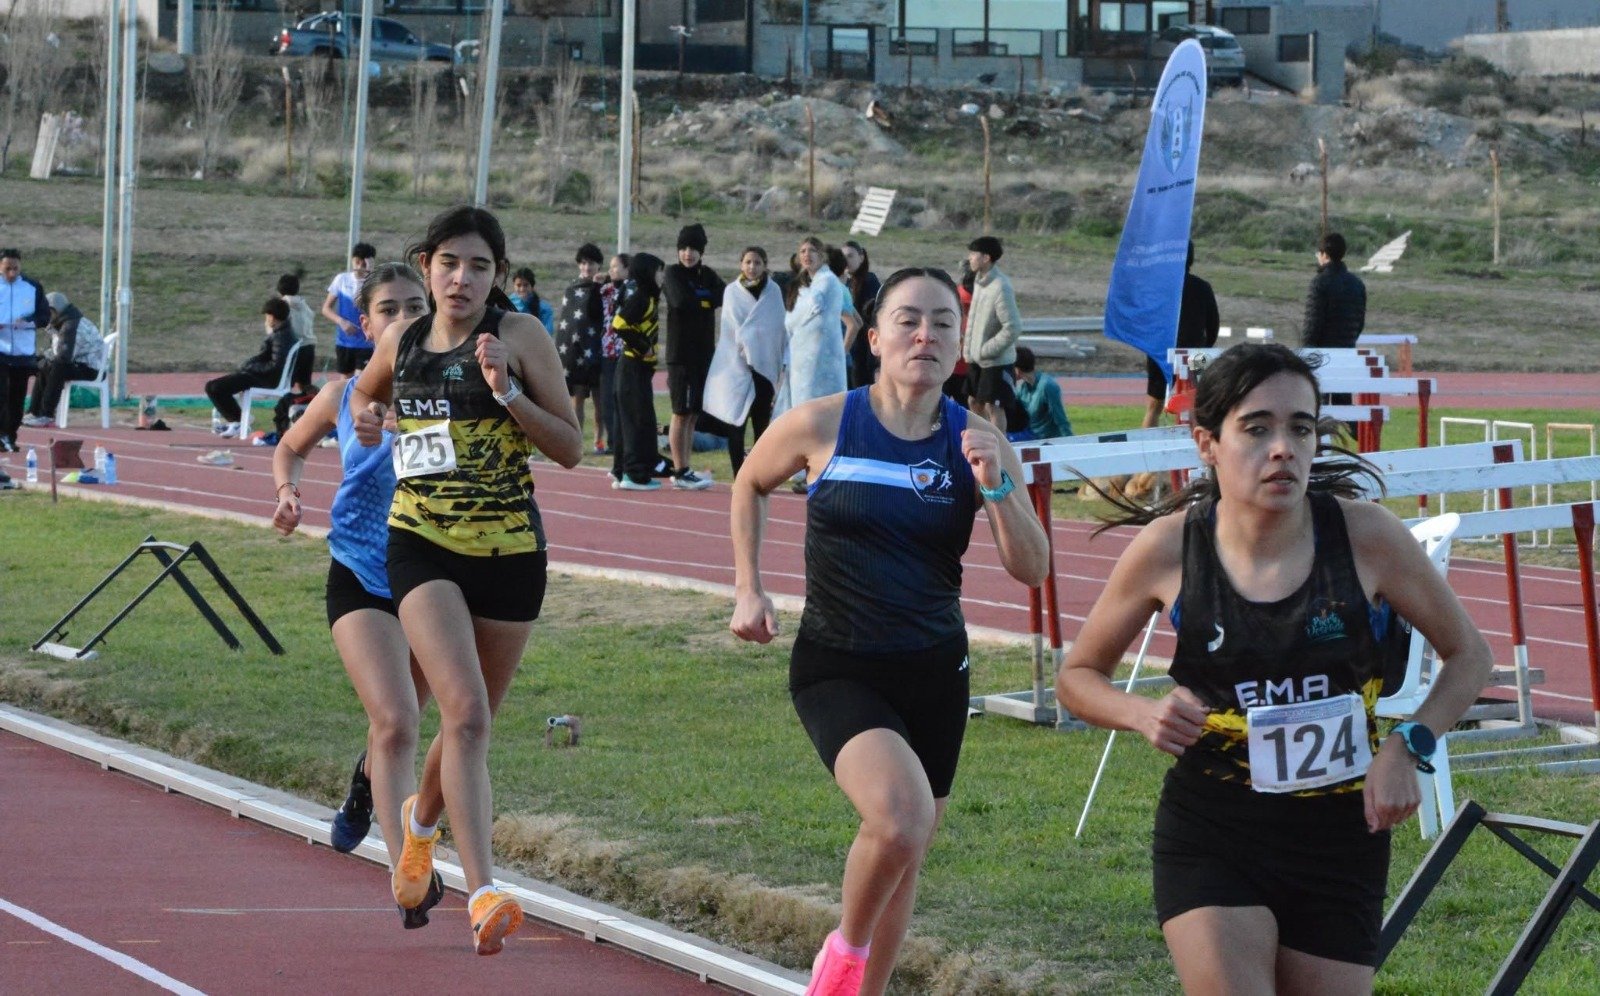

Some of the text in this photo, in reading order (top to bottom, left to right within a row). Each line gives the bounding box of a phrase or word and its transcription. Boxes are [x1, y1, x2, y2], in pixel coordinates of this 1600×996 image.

[399, 398, 451, 417] E.M.A
[394, 432, 447, 472] 125
[1235, 674, 1330, 709] E.M.A
[1262, 713, 1357, 783] 124
